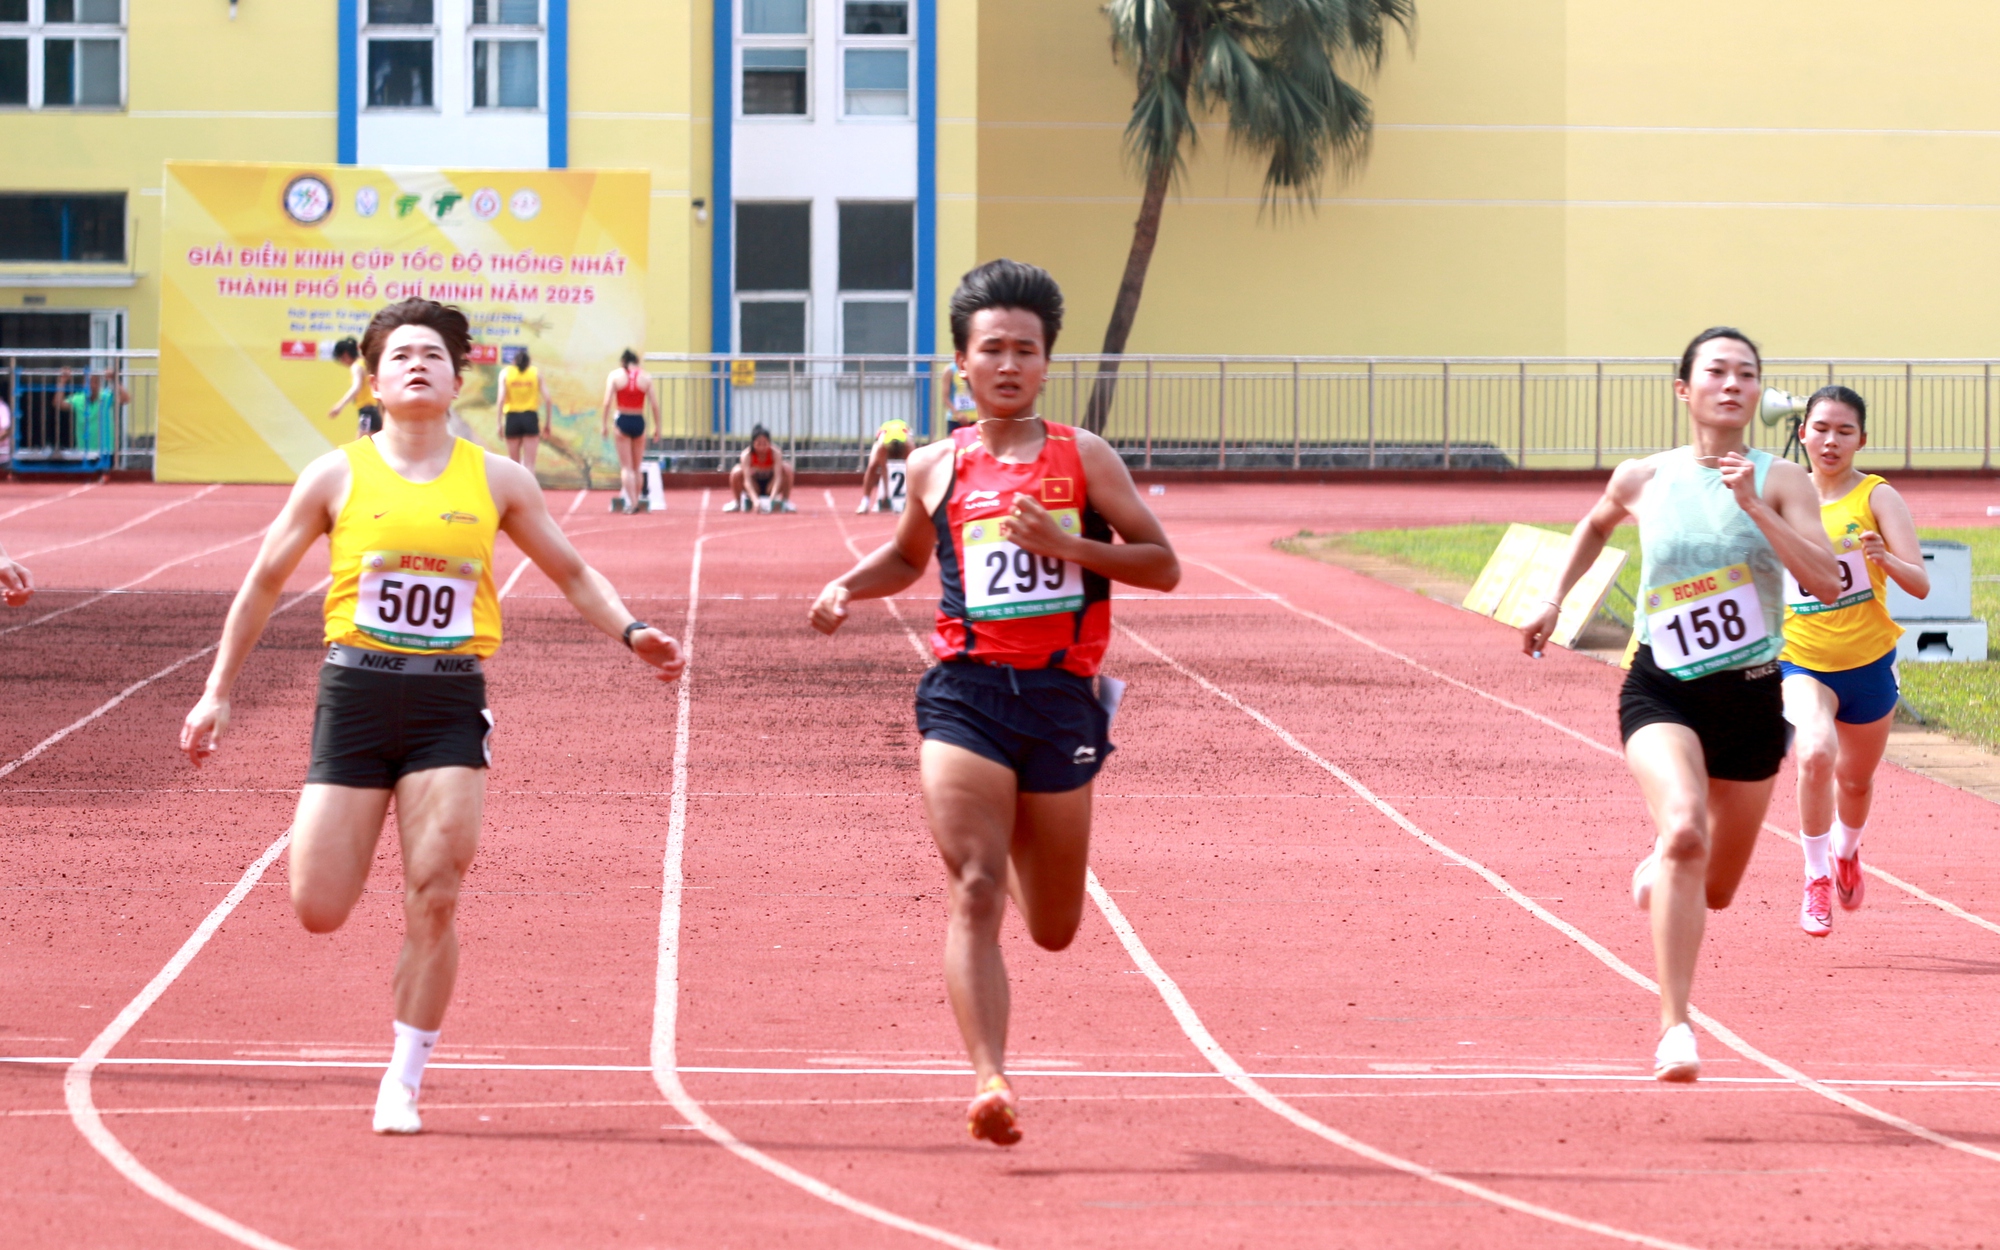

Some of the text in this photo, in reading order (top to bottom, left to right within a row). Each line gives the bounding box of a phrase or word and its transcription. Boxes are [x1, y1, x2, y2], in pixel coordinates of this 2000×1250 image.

[188, 241, 627, 276] GIẢI ĐIỀN KINH CÚP TỐC ĐỘ THỐNG NHẤT
[217, 274, 595, 304] THÀNH PHỐ HỒ CHÍ MINH NĂM 2025
[891, 471, 906, 497] 2
[400, 555, 448, 573] HCMC
[986, 548, 1065, 596] 299
[1672, 576, 1718, 601] HCMC
[378, 579, 456, 629] 509
[1667, 599, 1746, 656] 158
[359, 653, 407, 671] NIKE
[433, 658, 475, 673] NIKE
